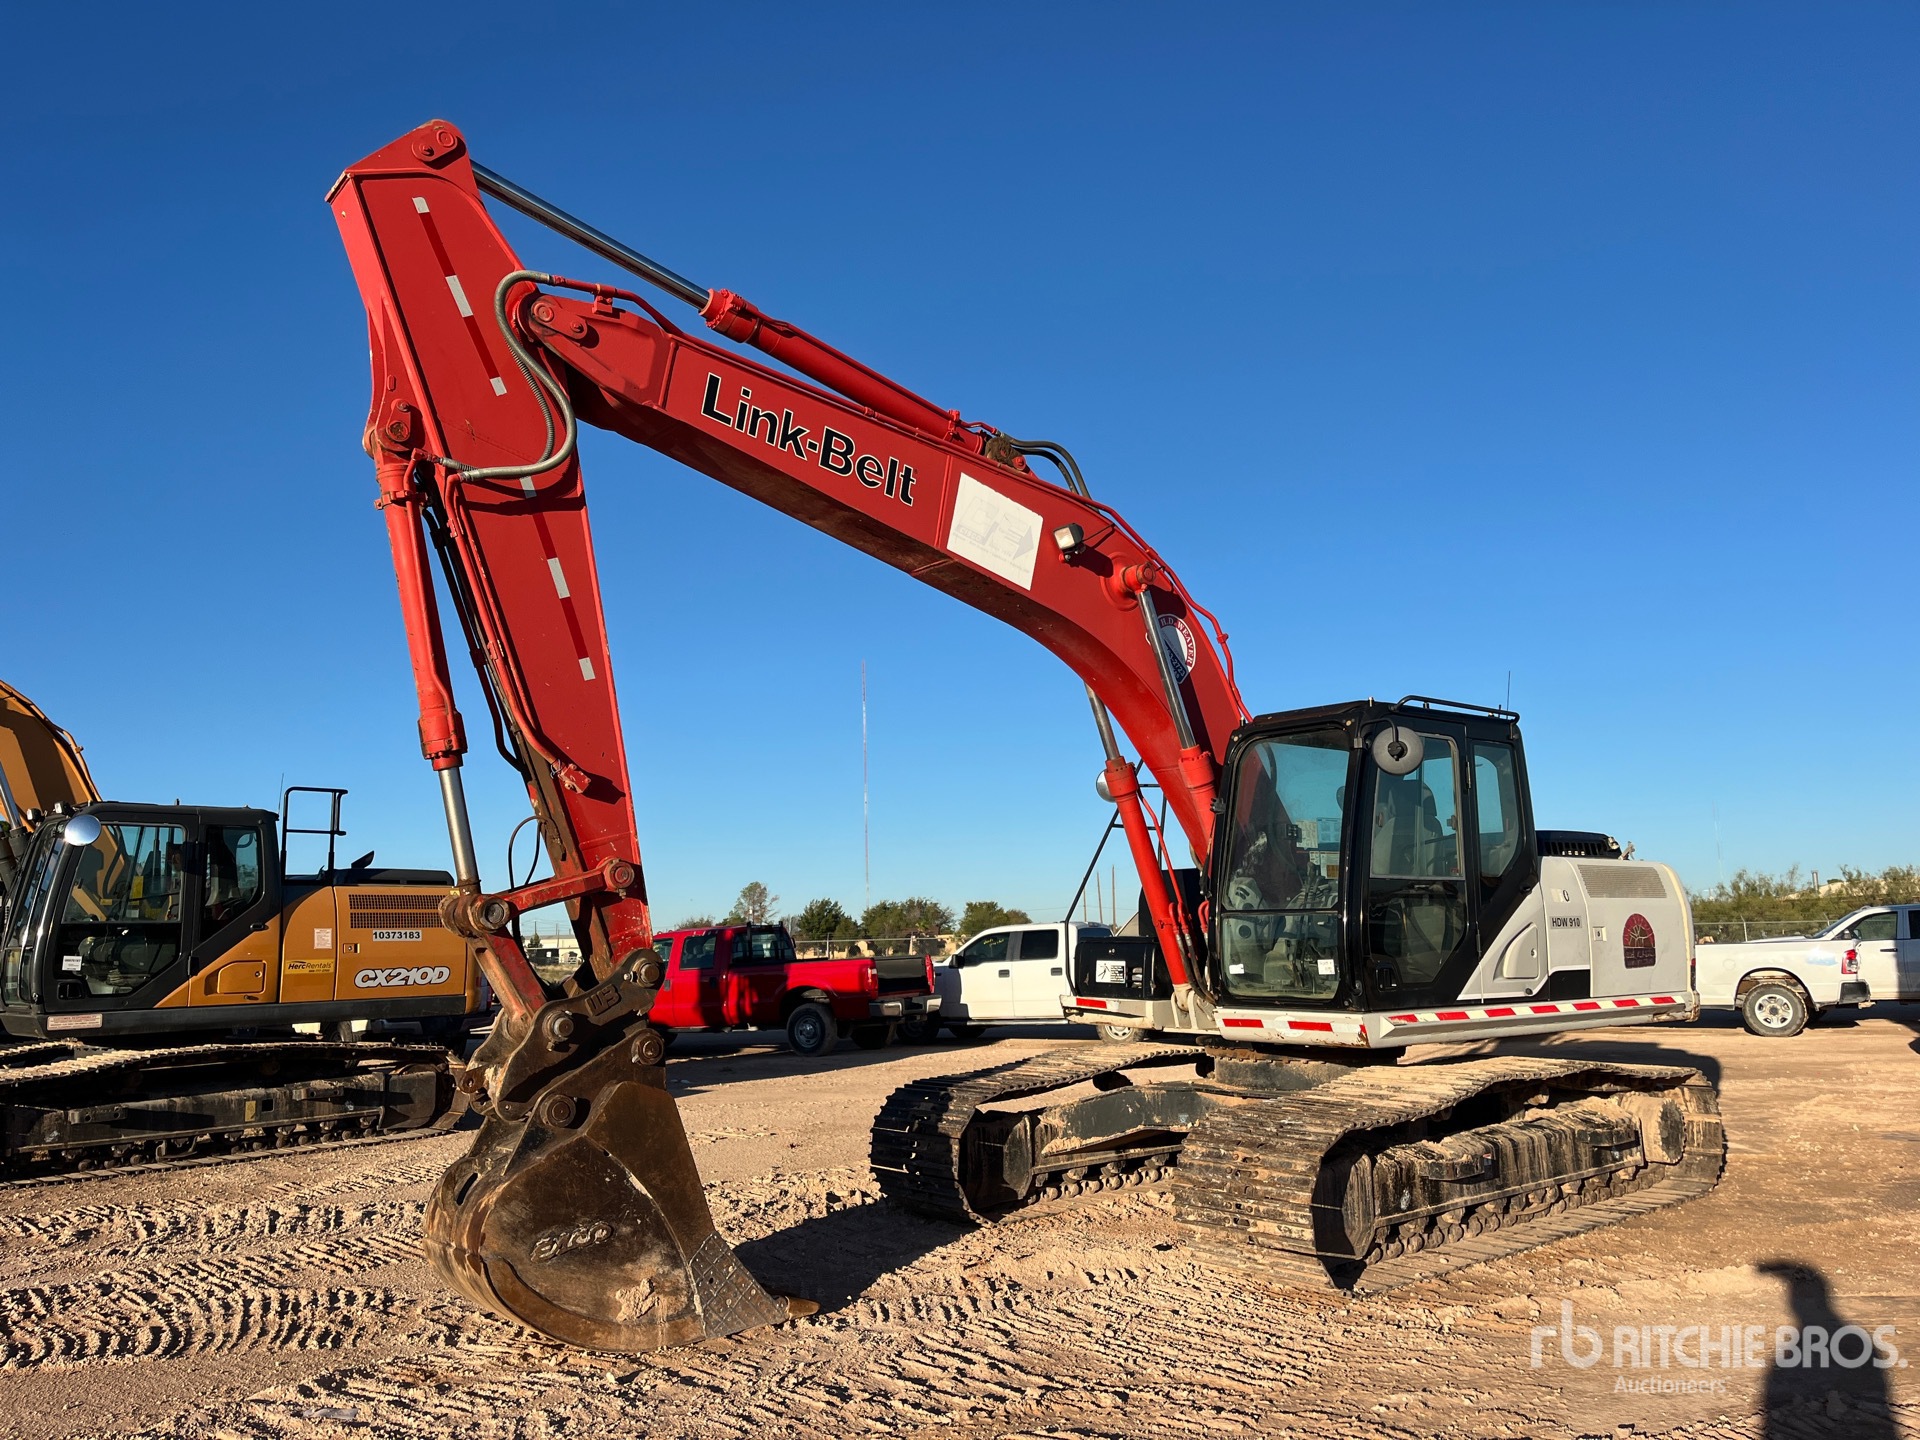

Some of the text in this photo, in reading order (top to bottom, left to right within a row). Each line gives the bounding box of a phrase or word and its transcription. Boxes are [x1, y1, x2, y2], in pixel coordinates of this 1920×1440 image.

[701, 372, 916, 507] Link-Belt
[1177, 621, 1194, 665] WEAVER
[1551, 917, 1580, 927] HDW 910
[373, 931, 421, 940] 10373183
[354, 966, 450, 988] CX210D
